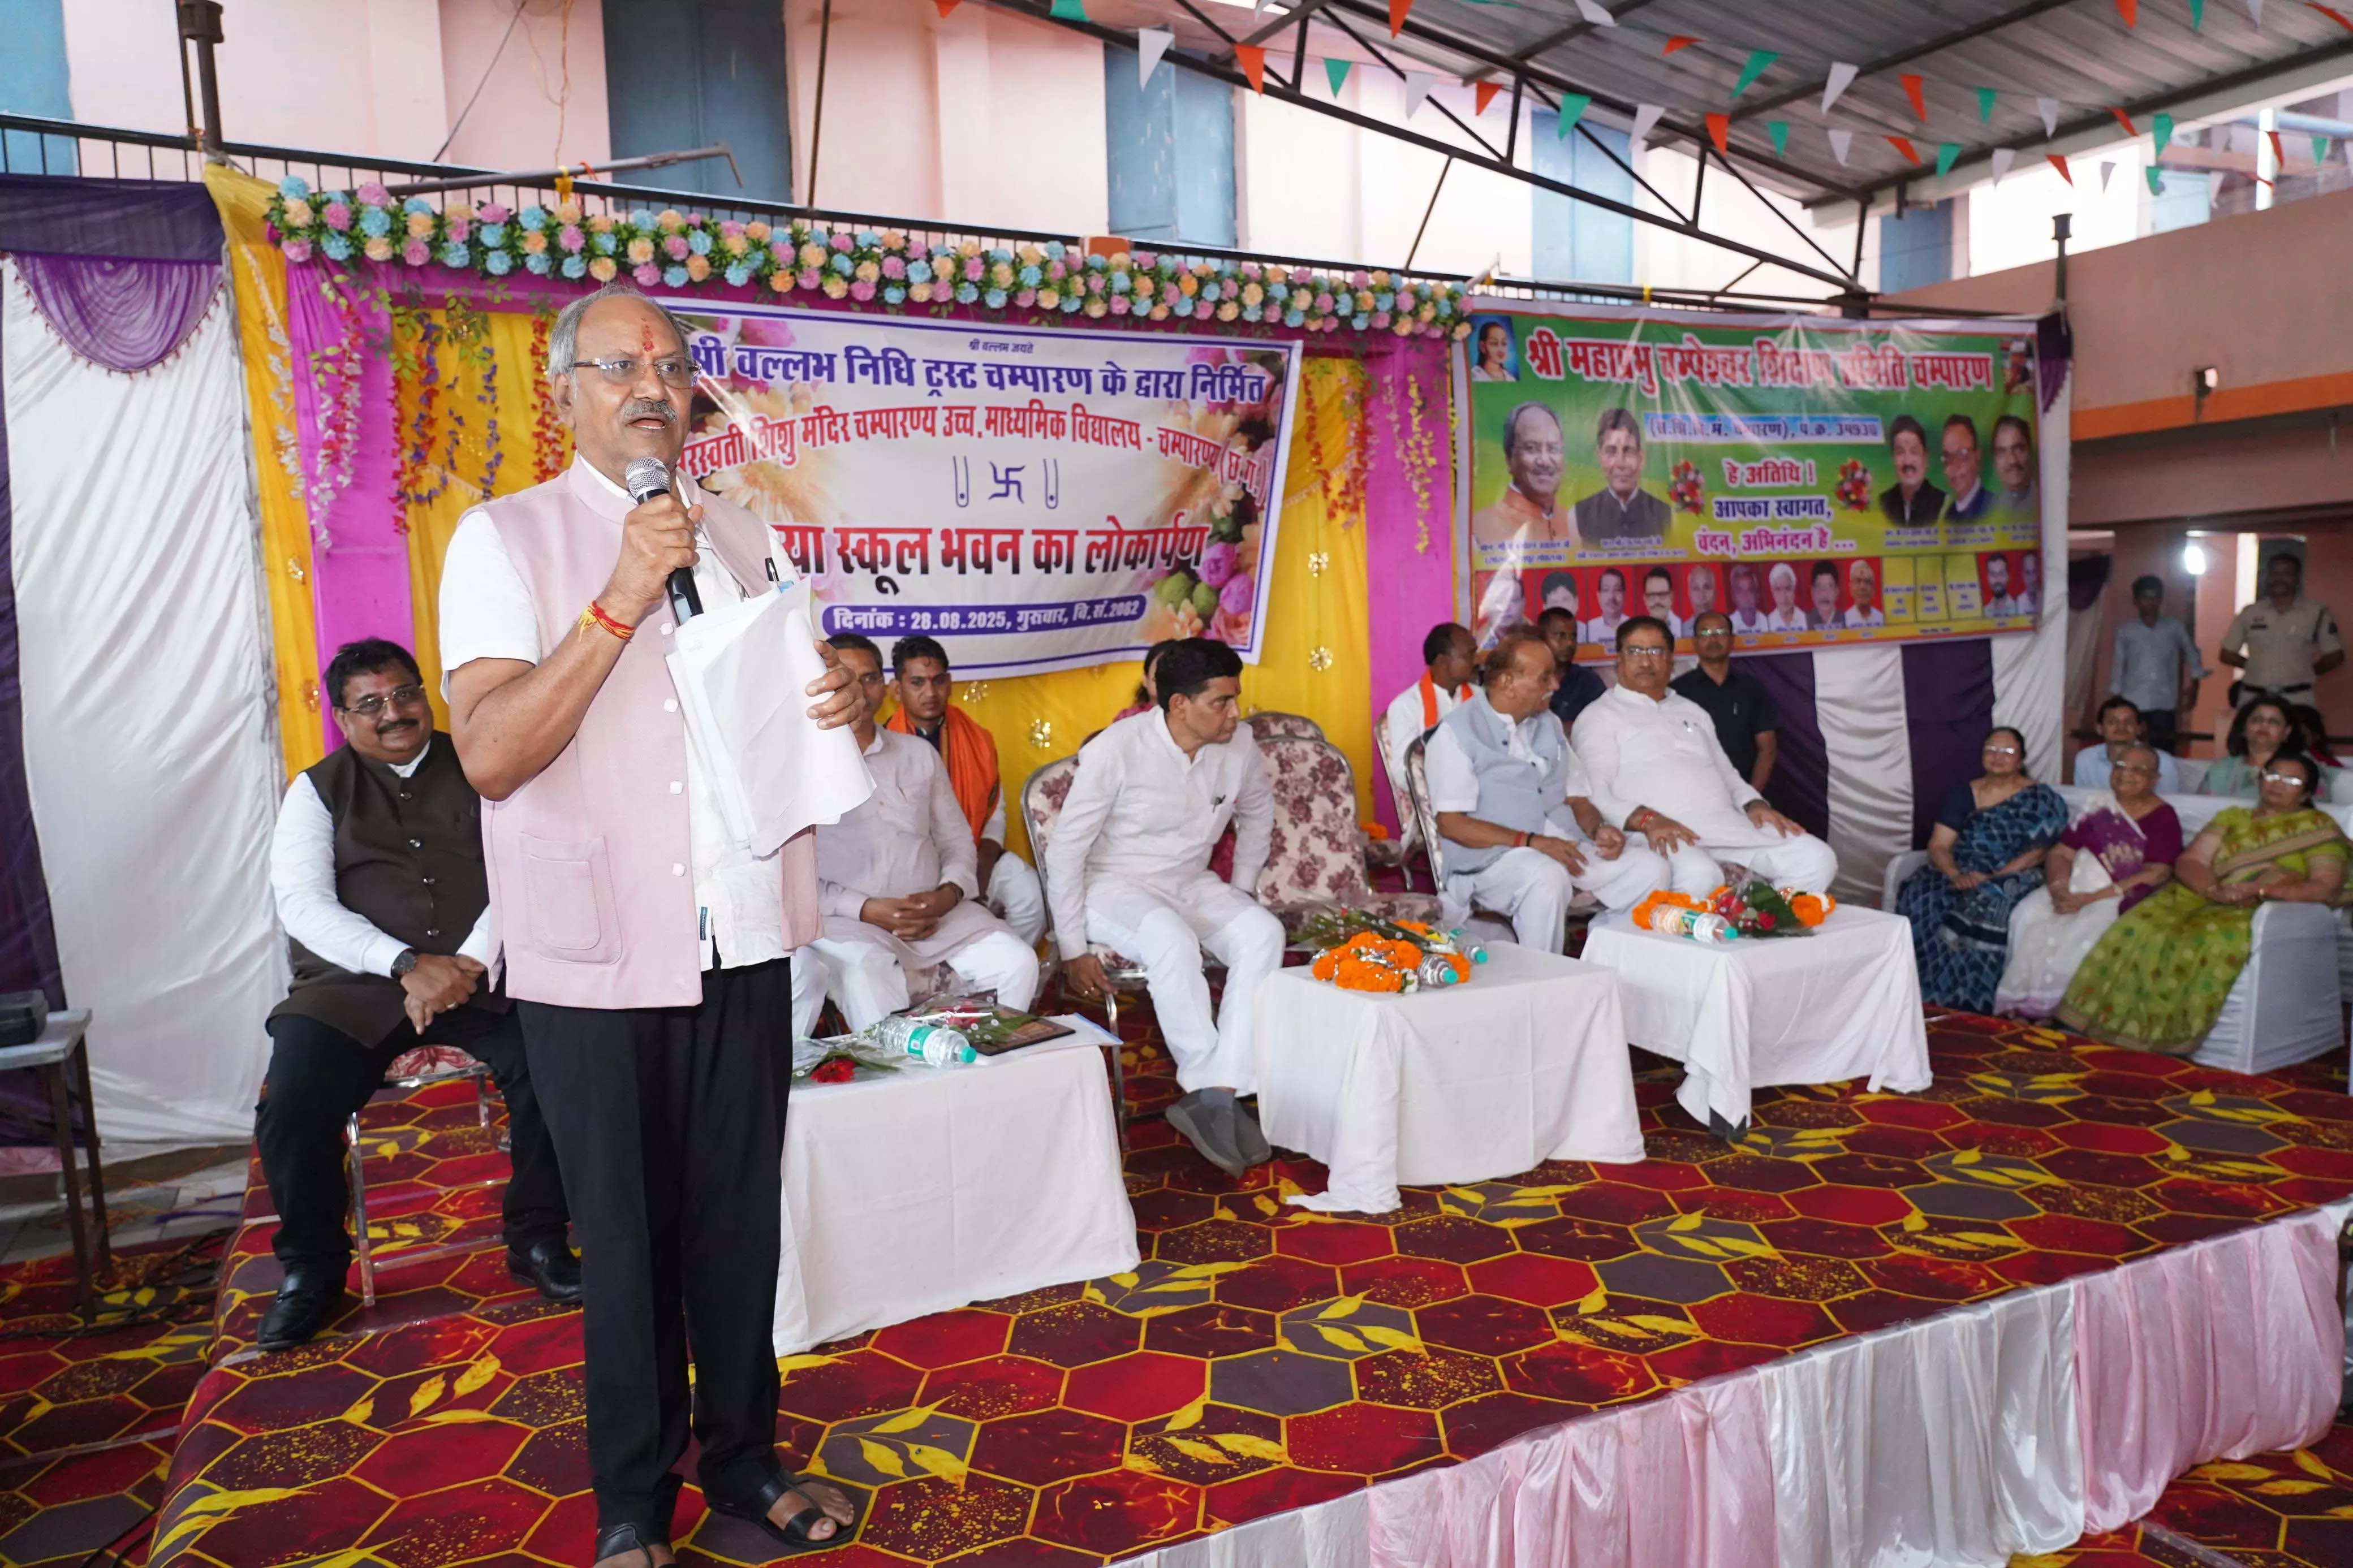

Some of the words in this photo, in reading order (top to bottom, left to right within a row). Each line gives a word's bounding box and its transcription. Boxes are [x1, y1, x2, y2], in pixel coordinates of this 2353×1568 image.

[735, 347, 837, 383] वल्लभ
[844, 345, 916, 386] निधि
[922, 359, 977, 396] ट्रस्ट
[982, 362, 1092, 395] चम्पारण
[1098, 361, 1127, 395] के
[1134, 370, 1186, 399] द्वारा
[1191, 364, 1265, 402] निर्मित
[1528, 329, 1562, 375] श्री
[1912, 356, 1991, 388] चम्पारण
[749, 416, 798, 466] शिशु
[801, 405, 851, 448] मंदिर
[853, 406, 938, 440] चम्पारण्य
[1071, 402, 1143, 451] विद्यालय
[1726, 462, 1739, 483] हे
[1746, 461, 1800, 483] अतिथि
[1714, 500, 1769, 518] आपका
[1775, 499, 1831, 519] स्वागत,
[770, 525, 825, 573] या
[833, 526, 932, 596] स्कूल
[940, 528, 1024, 574] भवन
[1031, 529, 1079, 574] का
[1085, 511, 1210, 574] लोकार्पण
[1698, 528, 1736, 554] वंदन,
[1742, 527, 1813, 551] अभिनंदन
[1815, 526, 1828, 548] है
[833, 607, 895, 629] दिनांक
[911, 611, 1012, 630] 28.08.2025,
